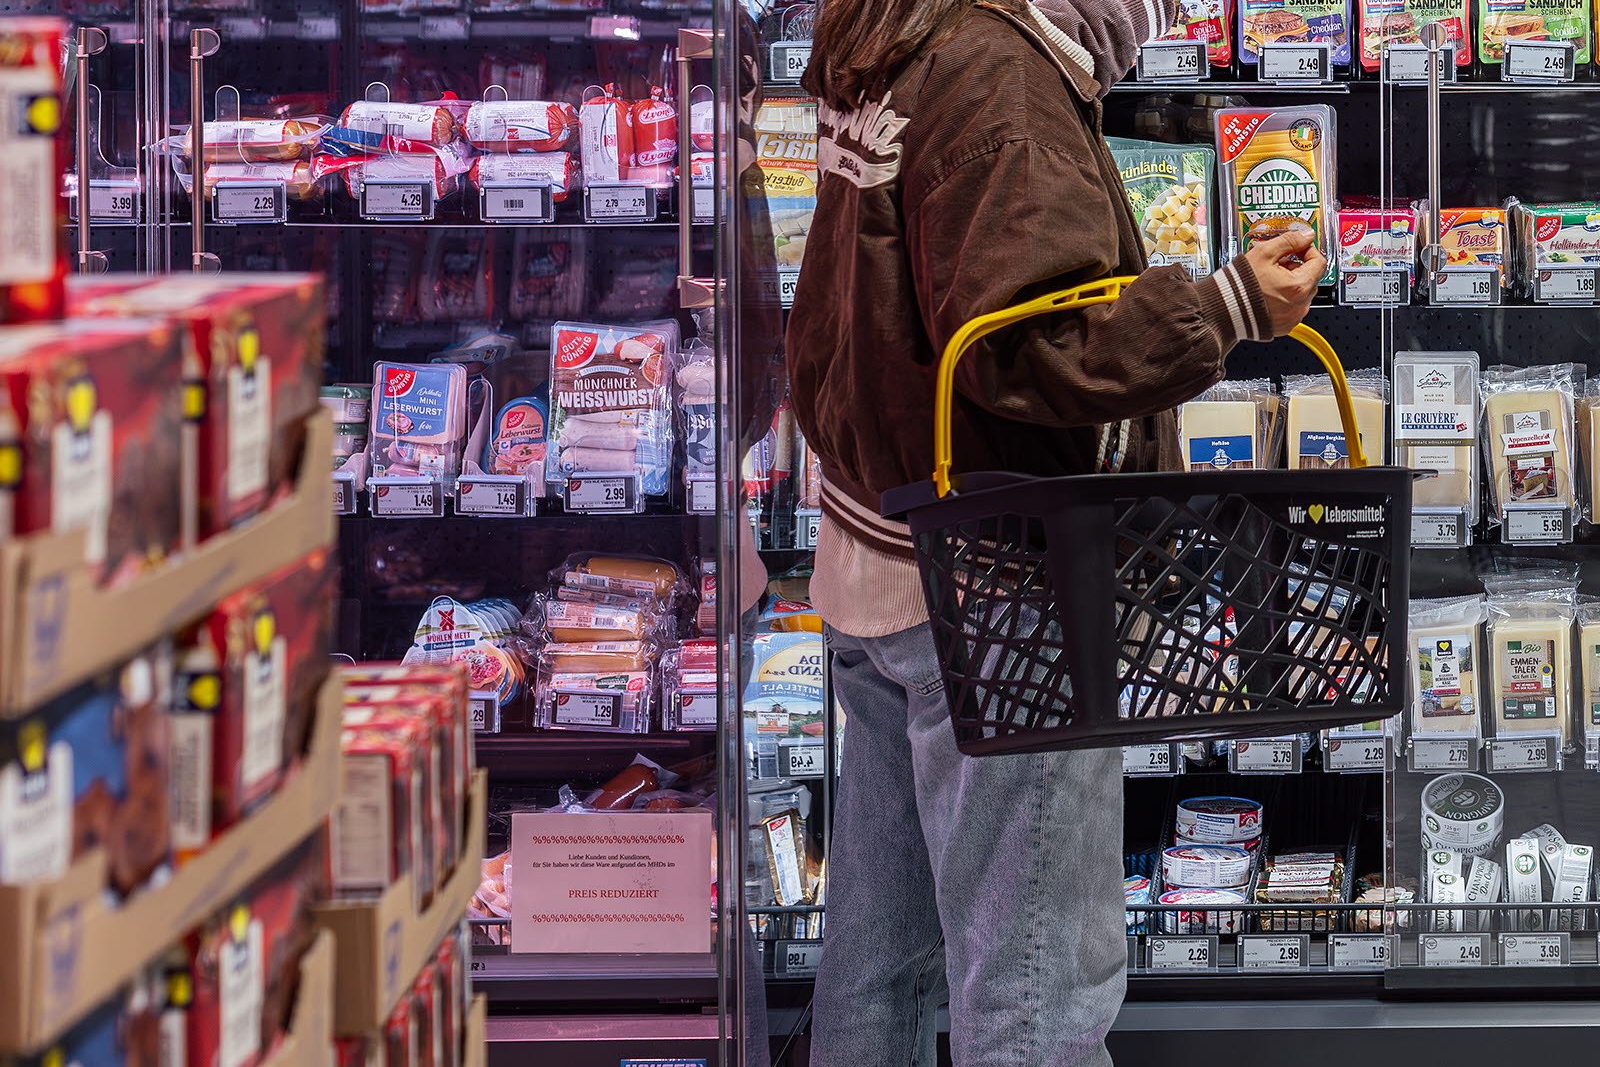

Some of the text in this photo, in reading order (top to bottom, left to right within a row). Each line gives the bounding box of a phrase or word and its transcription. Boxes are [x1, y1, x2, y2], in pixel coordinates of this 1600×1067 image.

[1420, 8, 1452, 16] SCHEIBEN
[1310, 20, 1342, 35] Cheddar
[1177, 55, 1198, 69] 2.49
[1120, 161, 1178, 178] rünländer
[1240, 183, 1318, 206] CHEDDAR
[111, 197, 131, 210] 3.99
[1456, 229, 1497, 246] Toast
[560, 336, 594, 363] GÜNSTIG
[573, 377, 638, 390] MÜNCHNER
[419, 397, 437, 405] MINI
[558, 389, 655, 408] WEISSWURST
[383, 400, 443, 417] LEBERWURST
[1401, 410, 1459, 424] LE GRUYÈRE
[501, 426, 542, 440] Leberwurst
[1507, 433, 1545, 444] Appenzeller
[1211, 439, 1230, 447] Hofkäse
[414, 493, 433, 507] 1.49
[1288, 505, 1308, 524] Wir
[427, 631, 471, 644] MÜHLEN METT
[1510, 657, 1542, 666] EMMEN-
[1514, 665, 1537, 675] TALER
[594, 704, 612, 718] 1.29
[1149, 751, 1169, 765] 2.99
[1272, 750, 1292, 763] 3.79
[1449, 749, 1468, 762] 2.79
[619, 854, 652, 862] Kundinnen,
[611, 862, 634, 870] aufgrund
[568, 889, 660, 899] PREIS REDUZIERT
[1188, 948, 1208, 961] 2.29
[1540, 945, 1560, 958] 3.99
